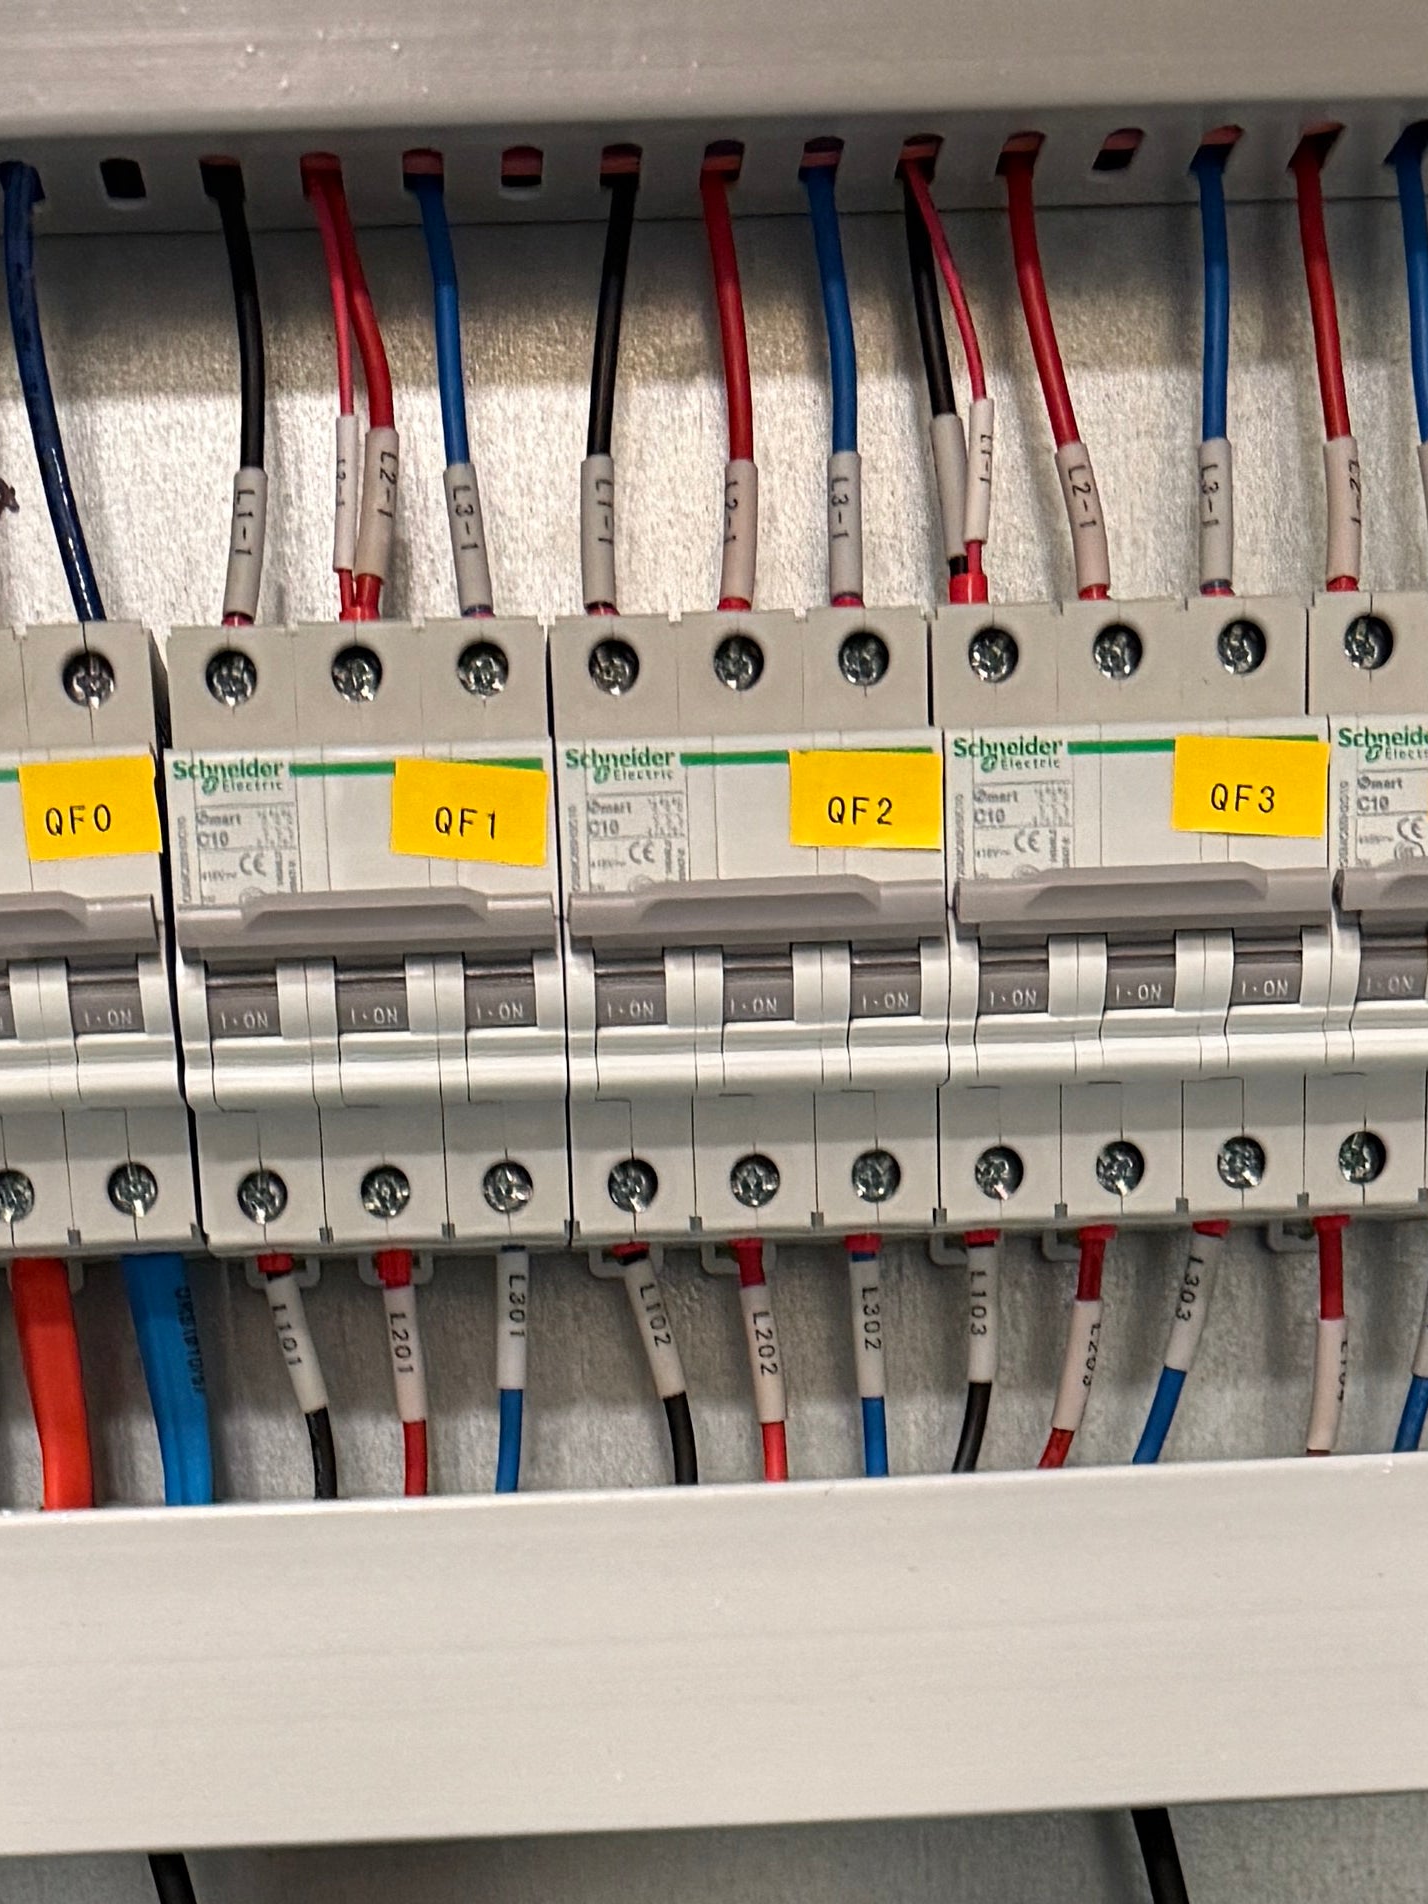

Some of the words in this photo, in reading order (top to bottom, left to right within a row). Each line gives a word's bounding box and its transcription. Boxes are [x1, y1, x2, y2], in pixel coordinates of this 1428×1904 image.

[376, 449, 399, 519] L2-1
[594, 478, 615, 547] L1-1
[829, 475, 850, 542] L3-1
[1067, 462, 1099, 530] L2-1
[1200, 462, 1221, 528] L3-1
[233, 488, 256, 557] L1-1
[452, 485, 481, 553] L3-1
[173, 759, 285, 783] Schneider
[565, 747, 676, 772] Schneider
[613, 768, 674, 782] Electric
[953, 735, 1064, 760] Schneider
[1001, 756, 1061, 771] Electric
[222, 780, 285, 794] Electric
[827, 796, 894, 826] QF2
[1210, 783, 1277, 814] QF3
[434, 806, 497, 841] QF1
[507, 1273, 526, 1339] L301
[639, 1282, 672, 1348] L102
[860, 1285, 883, 1352] L302
[969, 1269, 988, 1337] L103
[1174, 1253, 1205, 1322] L303
[271, 1302, 303, 1368] L101
[387, 1310, 415, 1375] L201
[752, 1309, 779, 1377] L202
